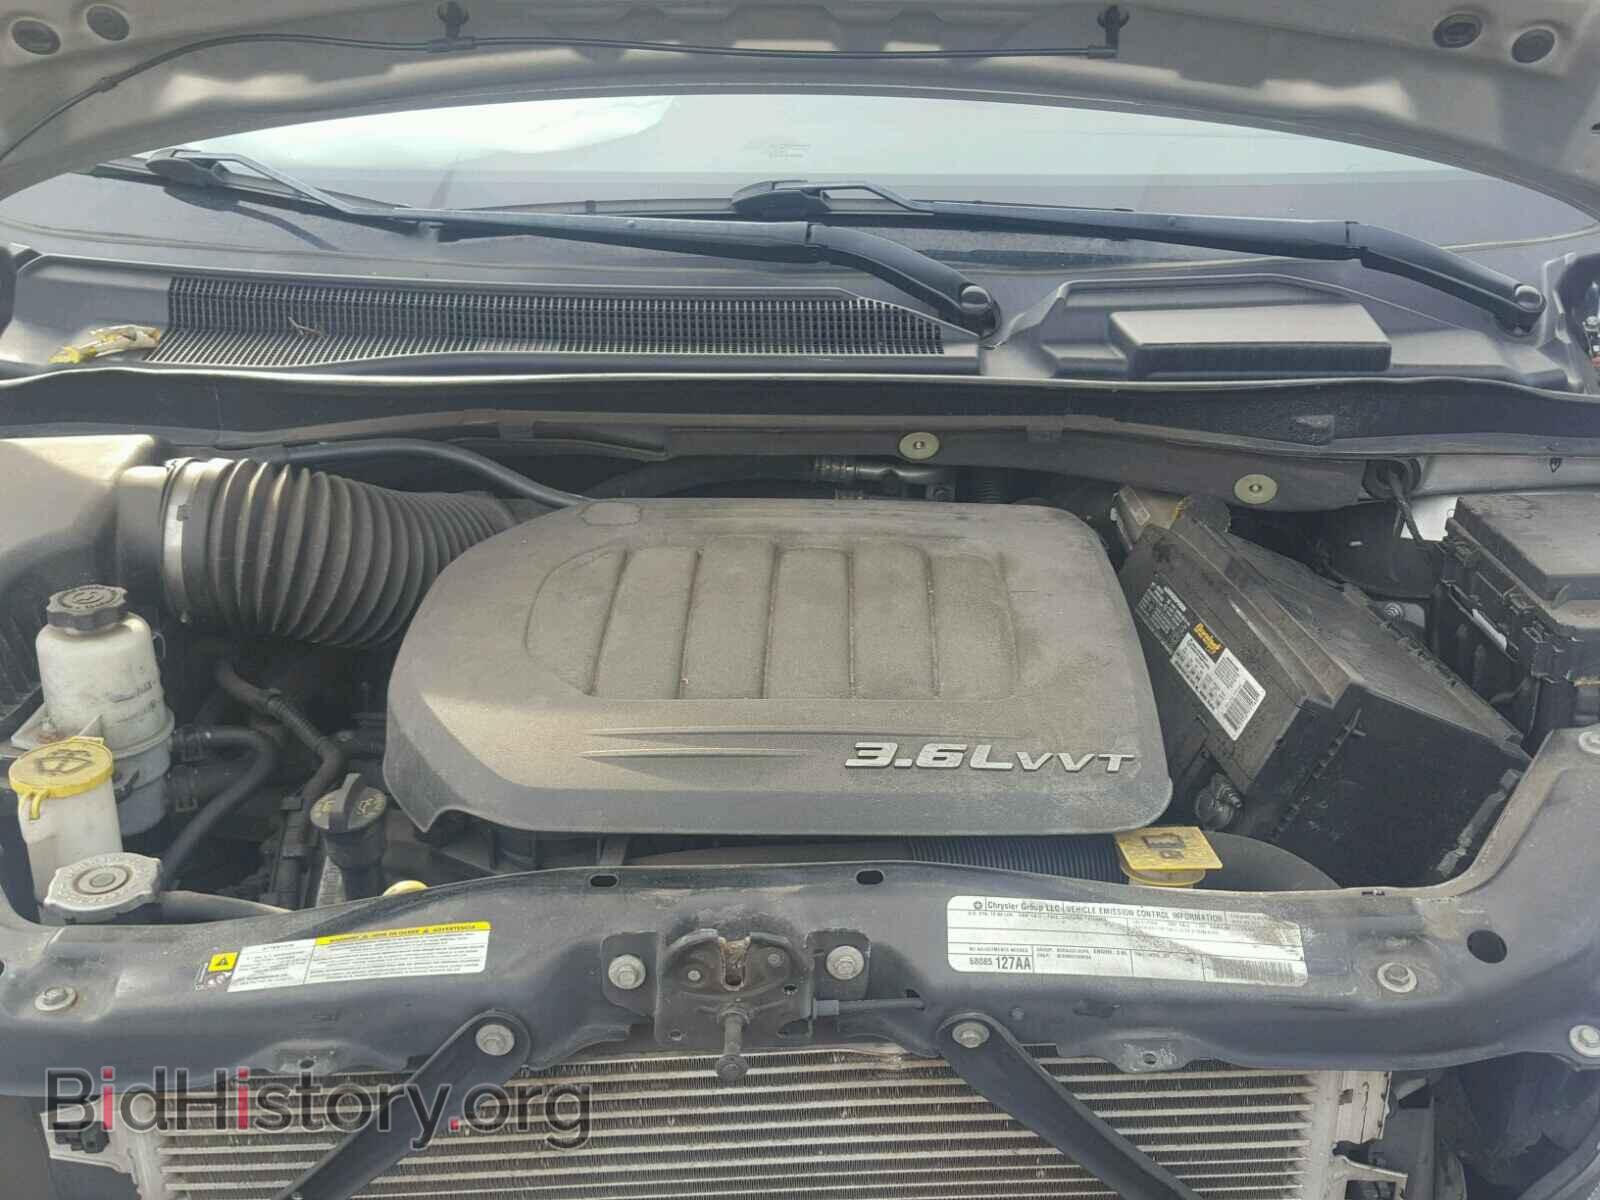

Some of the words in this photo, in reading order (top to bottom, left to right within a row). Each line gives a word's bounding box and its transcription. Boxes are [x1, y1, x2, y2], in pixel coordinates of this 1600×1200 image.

[987, 900, 1018, 912] Chrysler
[1021, 902, 1045, 913] Group
[1046, 903, 1061, 913] LLC
[1066, 905, 1096, 915] VEHICLE
[1098, 906, 1135, 917] EMISSION
[1136, 909, 1169, 919] CONTROL
[1171, 911, 1222, 922] INFORMATION
[995, 956, 1032, 970] 127AA
